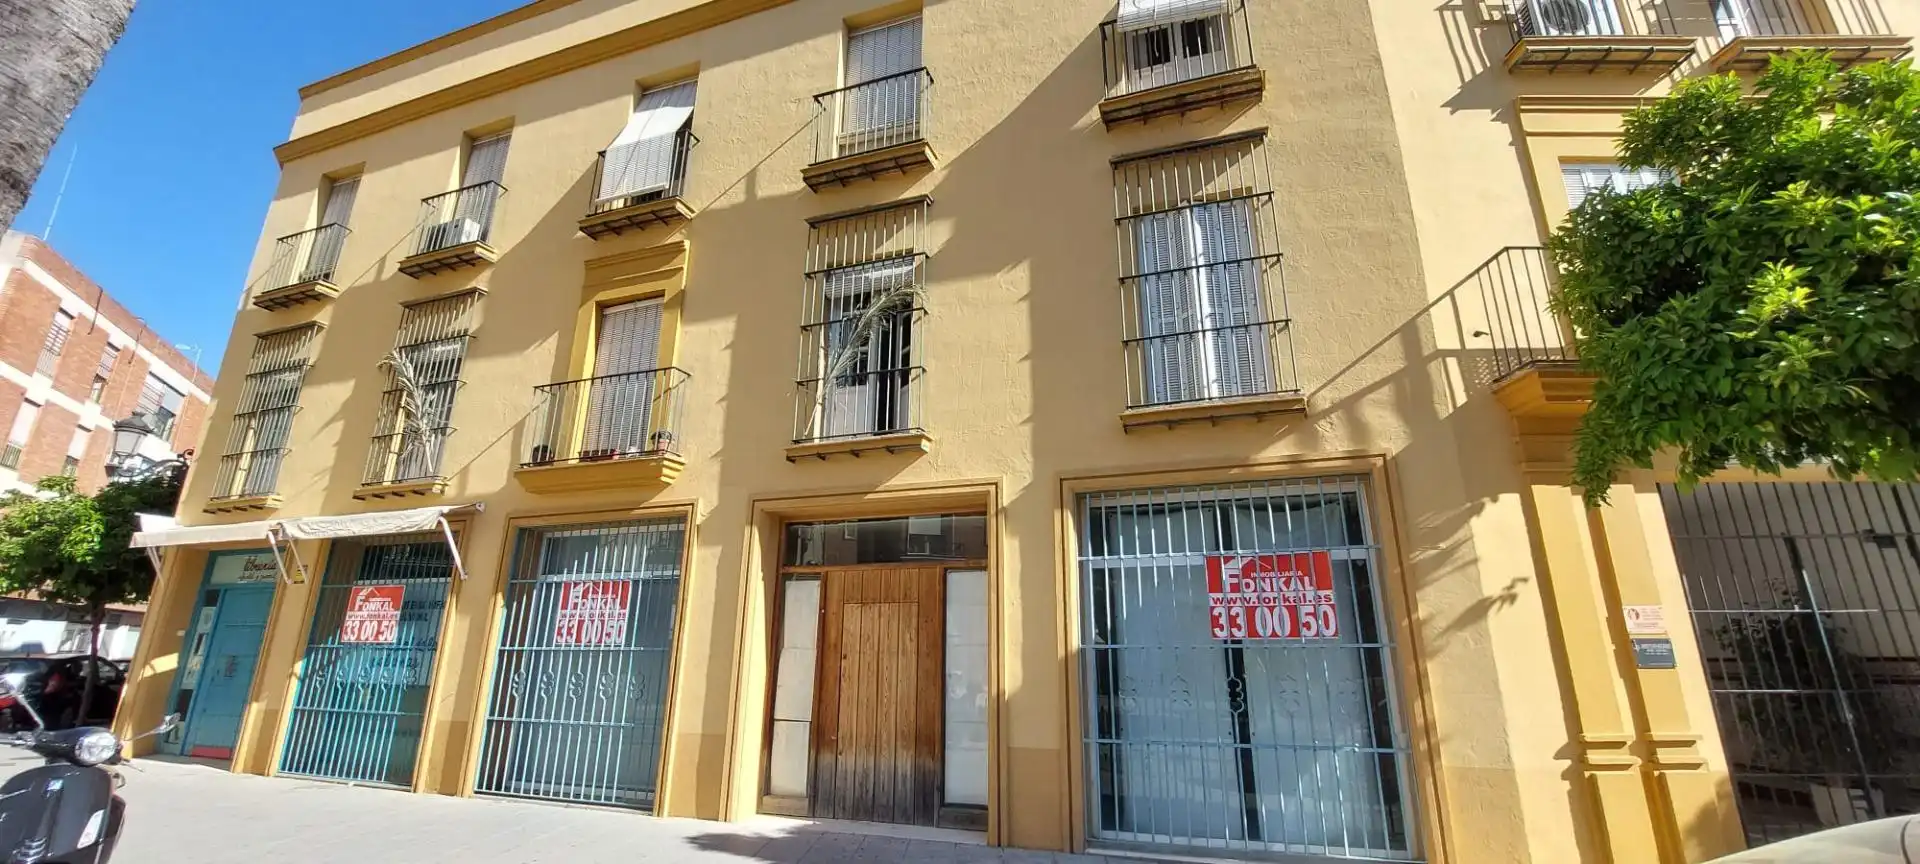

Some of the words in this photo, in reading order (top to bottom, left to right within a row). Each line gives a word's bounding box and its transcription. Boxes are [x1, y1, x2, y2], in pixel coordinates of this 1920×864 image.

[1225, 569, 1315, 593] FONKAL
[355, 595, 395, 611] FONKAL
[343, 620, 360, 641] 33
[360, 620, 379, 641] 00
[378, 620, 397, 641] 50
[556, 620, 577, 643] 33
[581, 620, 603, 643] 00
[604, 620, 626, 644] 50
[1212, 606, 1246, 637] 33
[1255, 606, 1291, 637] 00
[1301, 605, 1337, 637] 50
